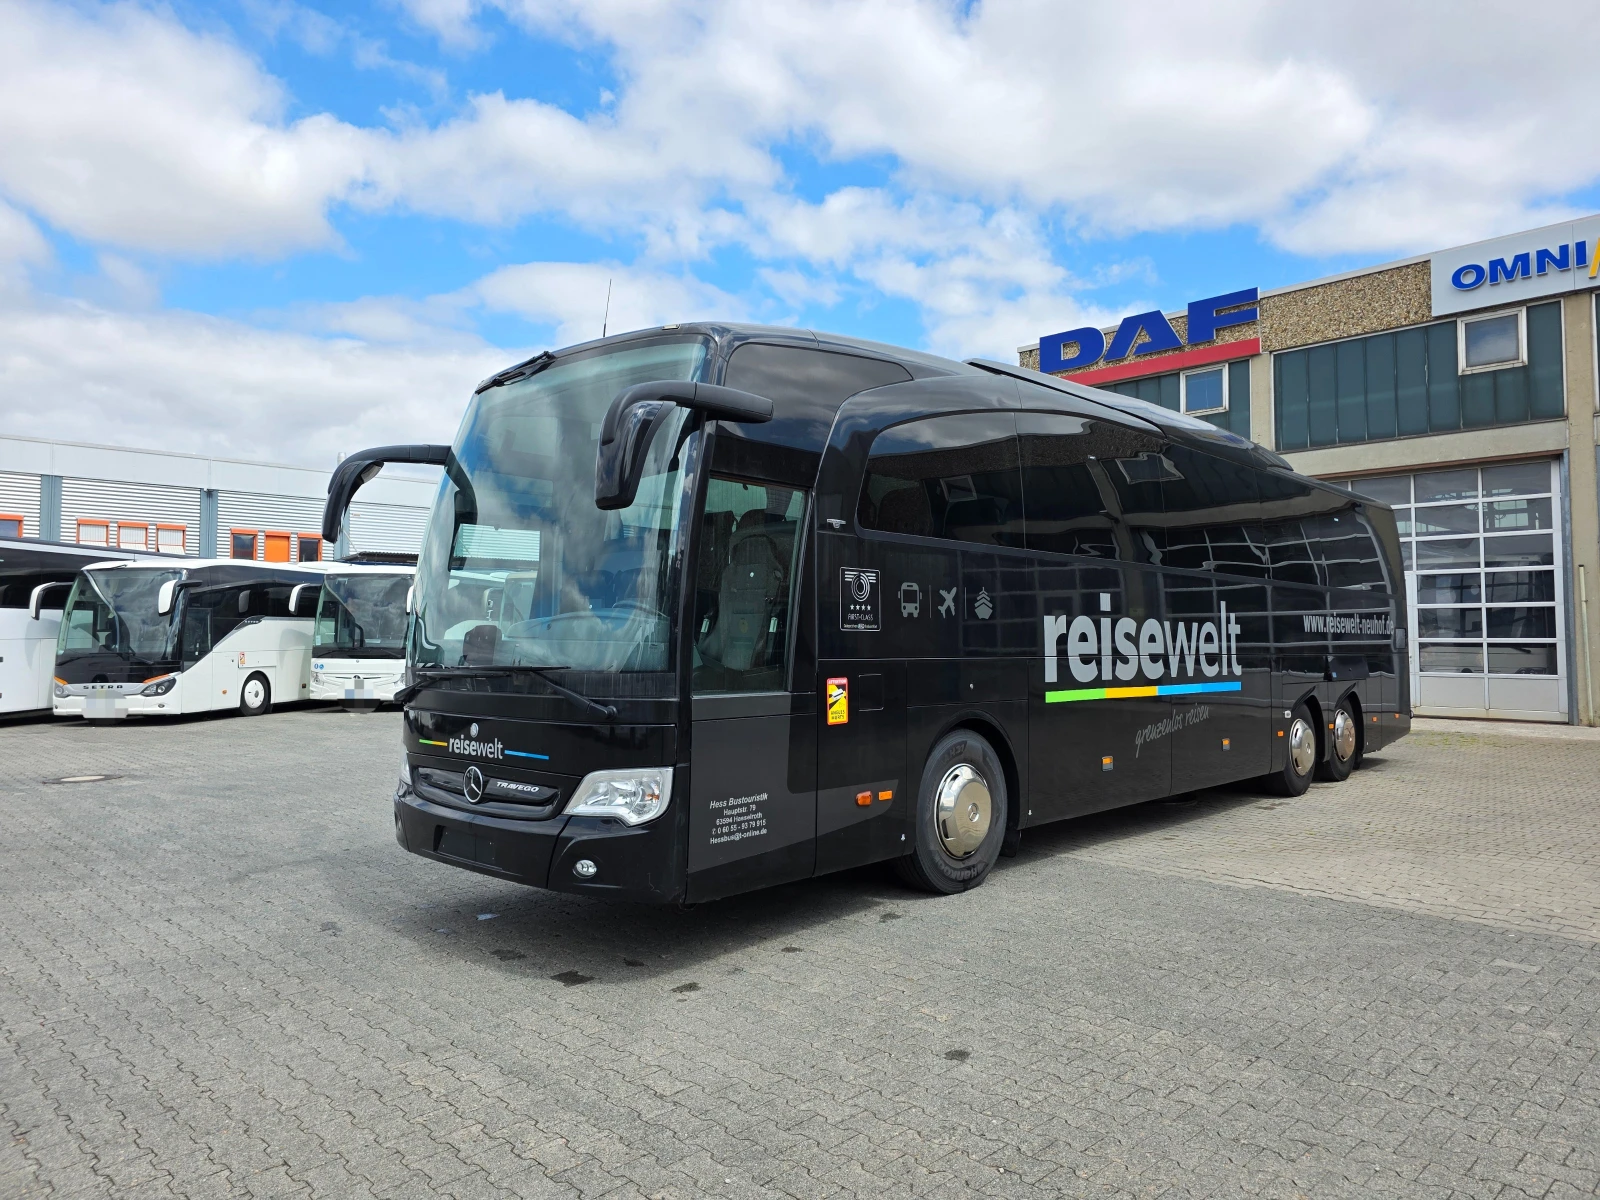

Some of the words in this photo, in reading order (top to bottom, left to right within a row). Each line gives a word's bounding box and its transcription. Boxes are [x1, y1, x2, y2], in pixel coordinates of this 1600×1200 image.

[1039, 287, 1260, 374] DAF
[1303, 611, 1394, 635] www.reisewelt-neuhof.de
[1043, 592, 1242, 683] reisewelt
[1135, 708, 1183, 758] grenzenlos
[1185, 702, 1210, 727] reisen
[448, 734, 504, 760] reisewelt
[496, 781, 540, 793] TRAVEGO
[710, 800, 728, 810] Hess
[728, 792, 769, 806] Bustouristik
